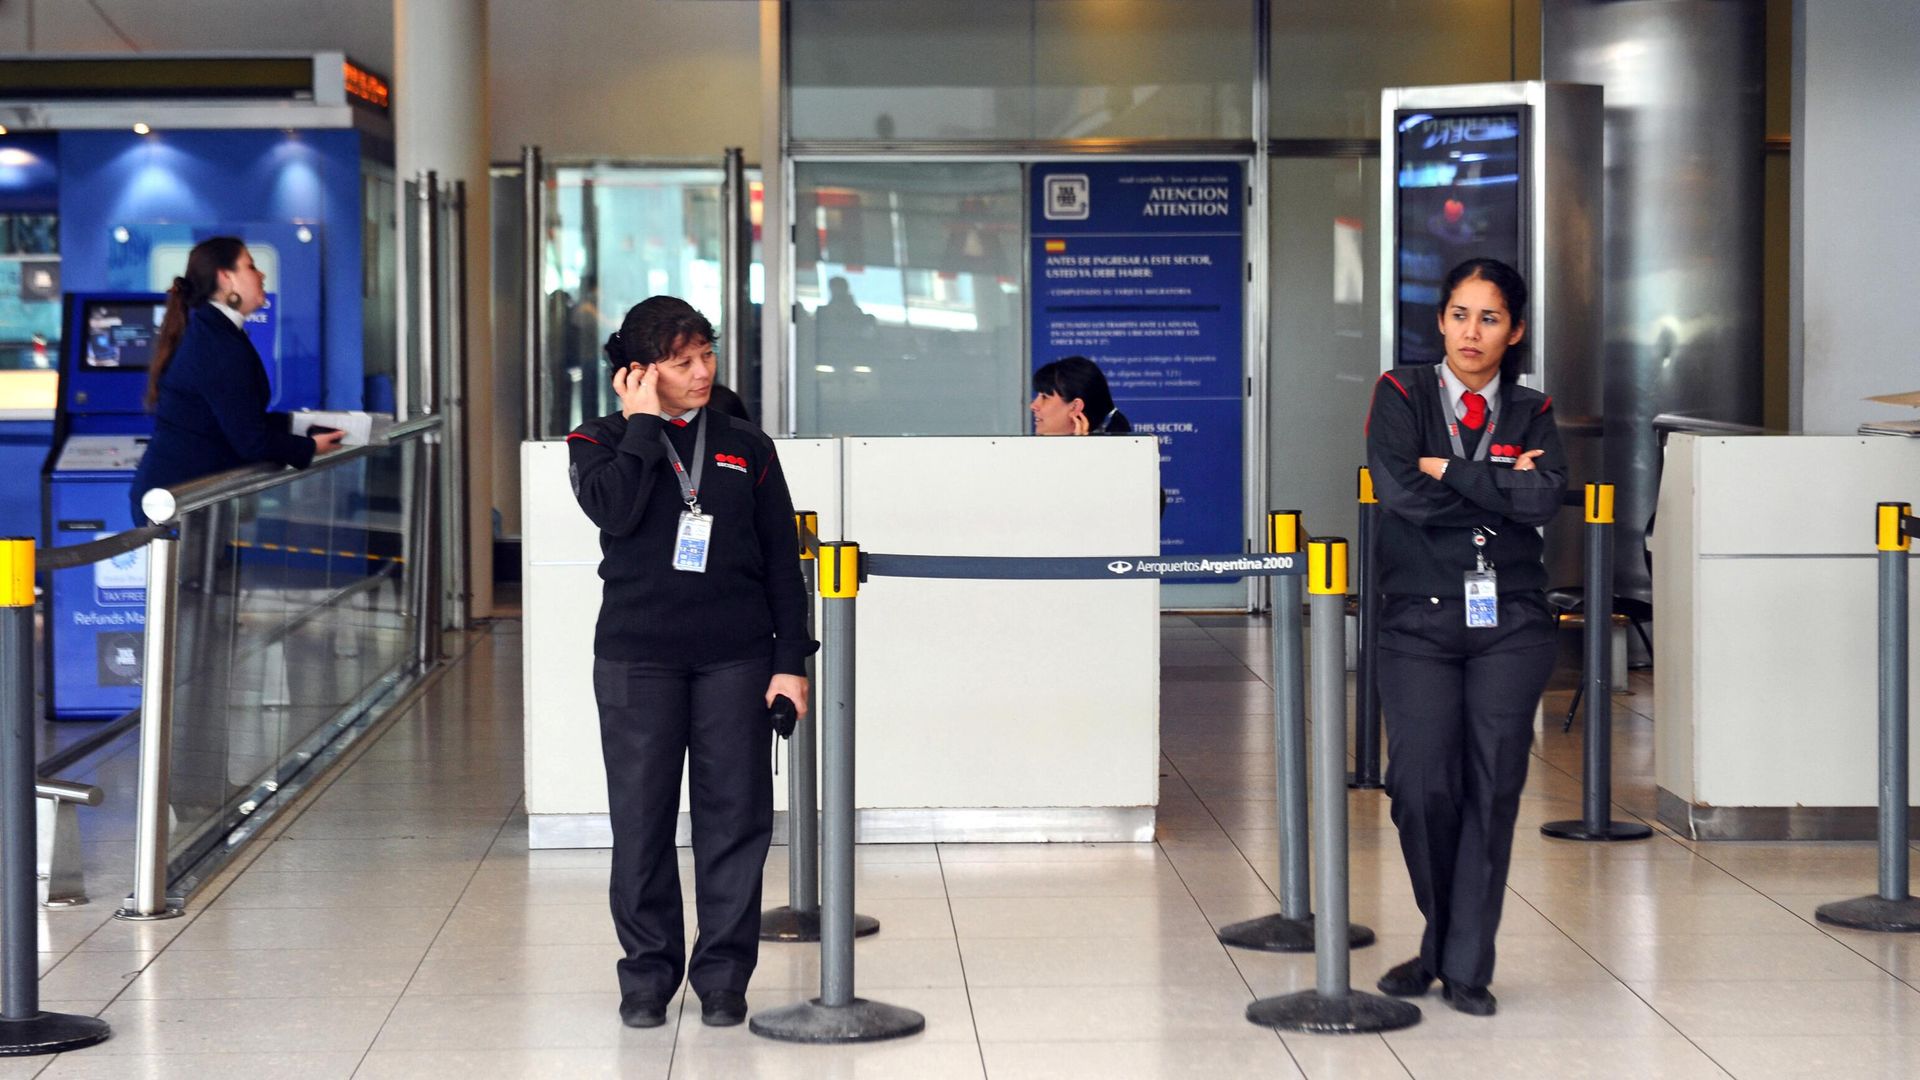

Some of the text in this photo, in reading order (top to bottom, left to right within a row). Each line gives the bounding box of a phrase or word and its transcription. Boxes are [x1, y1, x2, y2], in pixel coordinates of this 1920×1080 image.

[1149, 187, 1228, 200] ATENCION
[1142, 203, 1228, 216] ATTENTION
[1046, 256, 1076, 266] ANTES
[1078, 256, 1091, 266] DE
[1092, 256, 1140, 266] INGRESAR
[1142, 256, 1150, 265] A
[1151, 256, 1171, 265] ESTE
[1045, 269, 1078, 278] USTED
[1092, 269, 1116, 278] DEBE
[1134, 424, 1155, 432] THIS
[1263, 556, 1294, 569] 2000
[73, 611, 124, 626] Refunds
